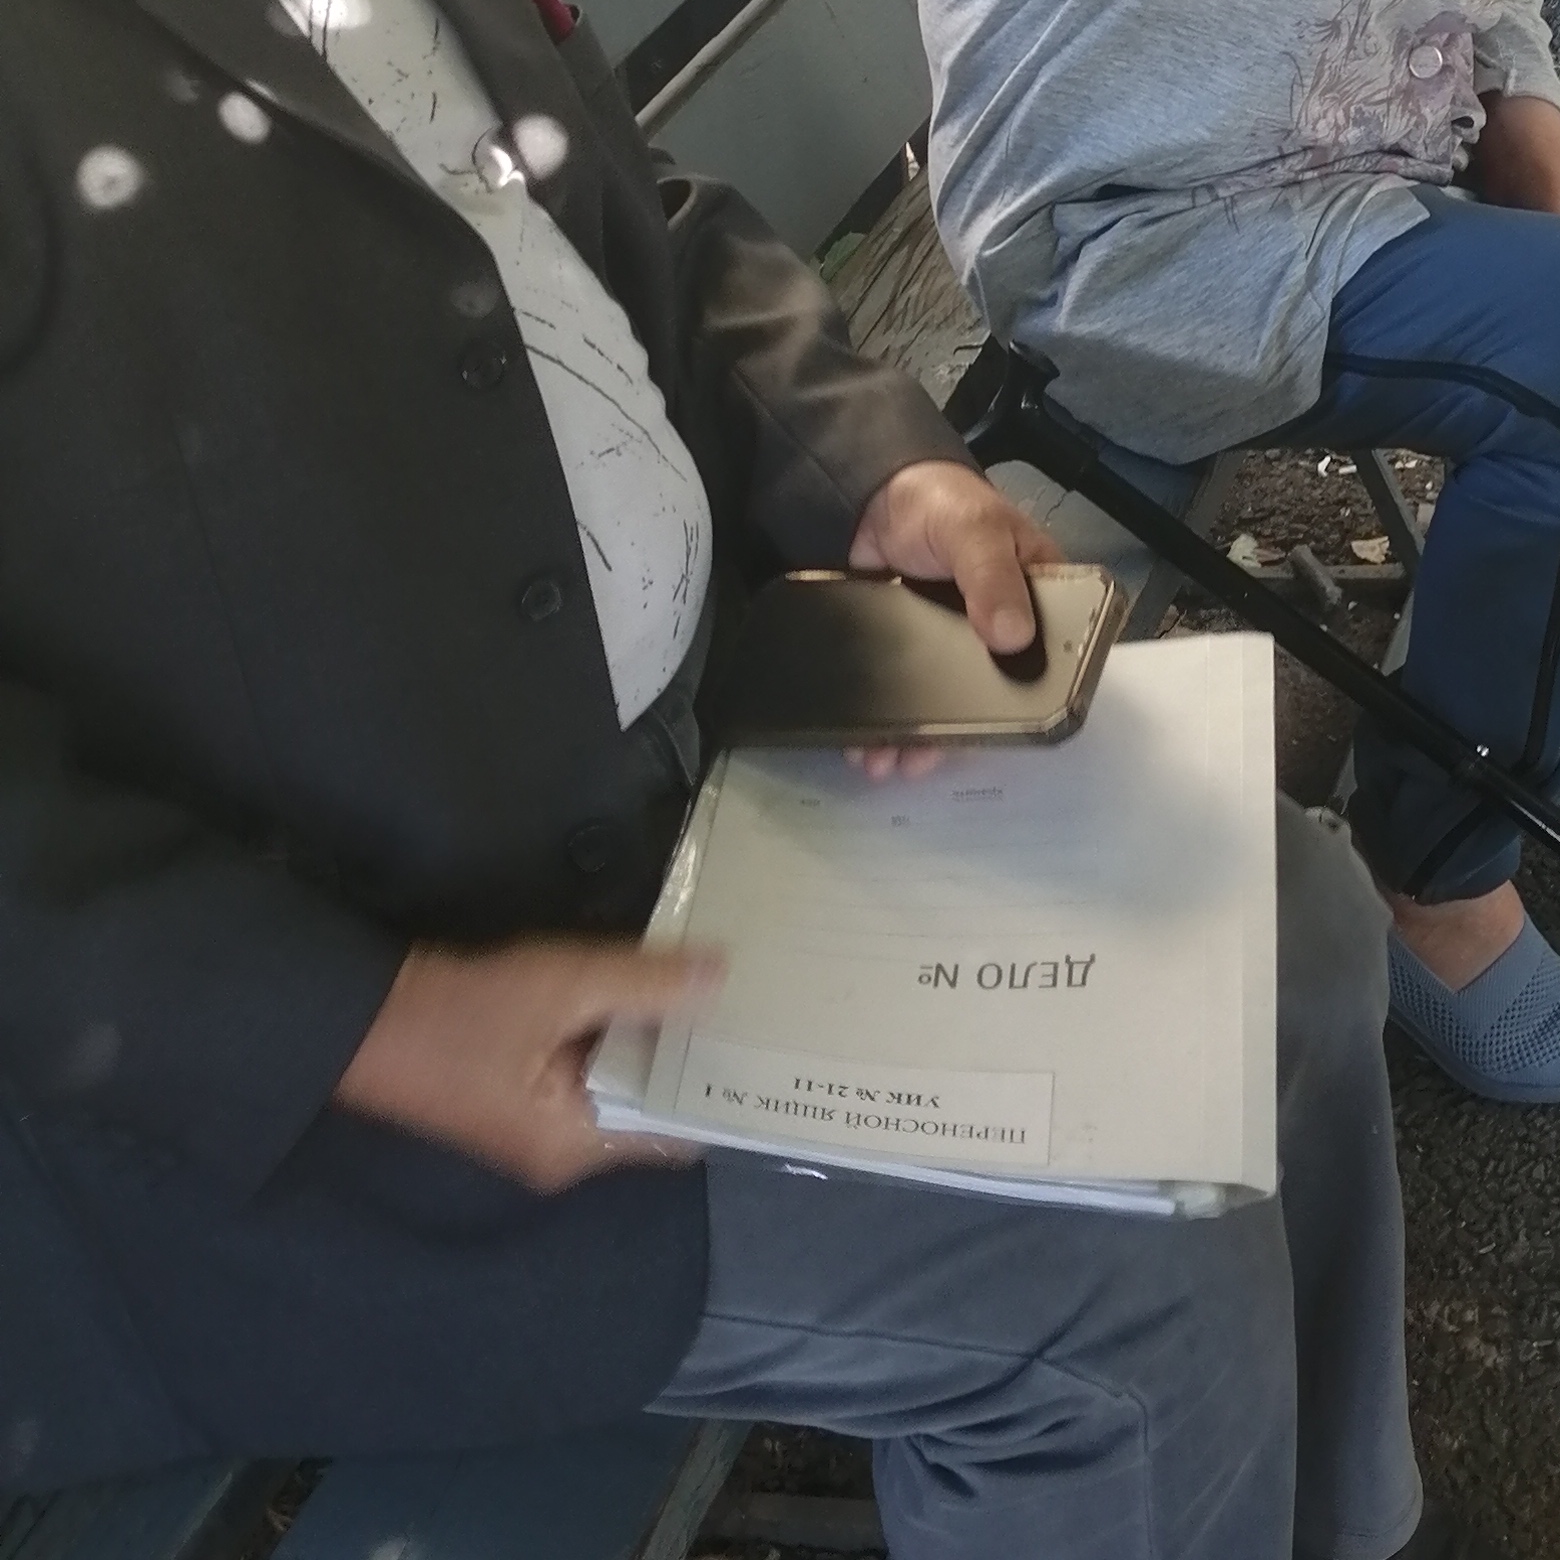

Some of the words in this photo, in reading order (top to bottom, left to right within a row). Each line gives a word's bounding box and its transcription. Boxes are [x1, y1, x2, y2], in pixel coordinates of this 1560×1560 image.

[918, 962, 960, 990] №
[976, 953, 1096, 990] ДЕЛО
[704, 1083, 712, 1099] 1
[721, 1086, 748, 1106] №
[793, 1077, 849, 1098] 21-11
[856, 1087, 881, 1103] №
[755, 1095, 837, 1122] ЯЩИК
[885, 1091, 940, 1109] УИК
[844, 1111, 1026, 1144] ПЕРЕНОСНОЙ
